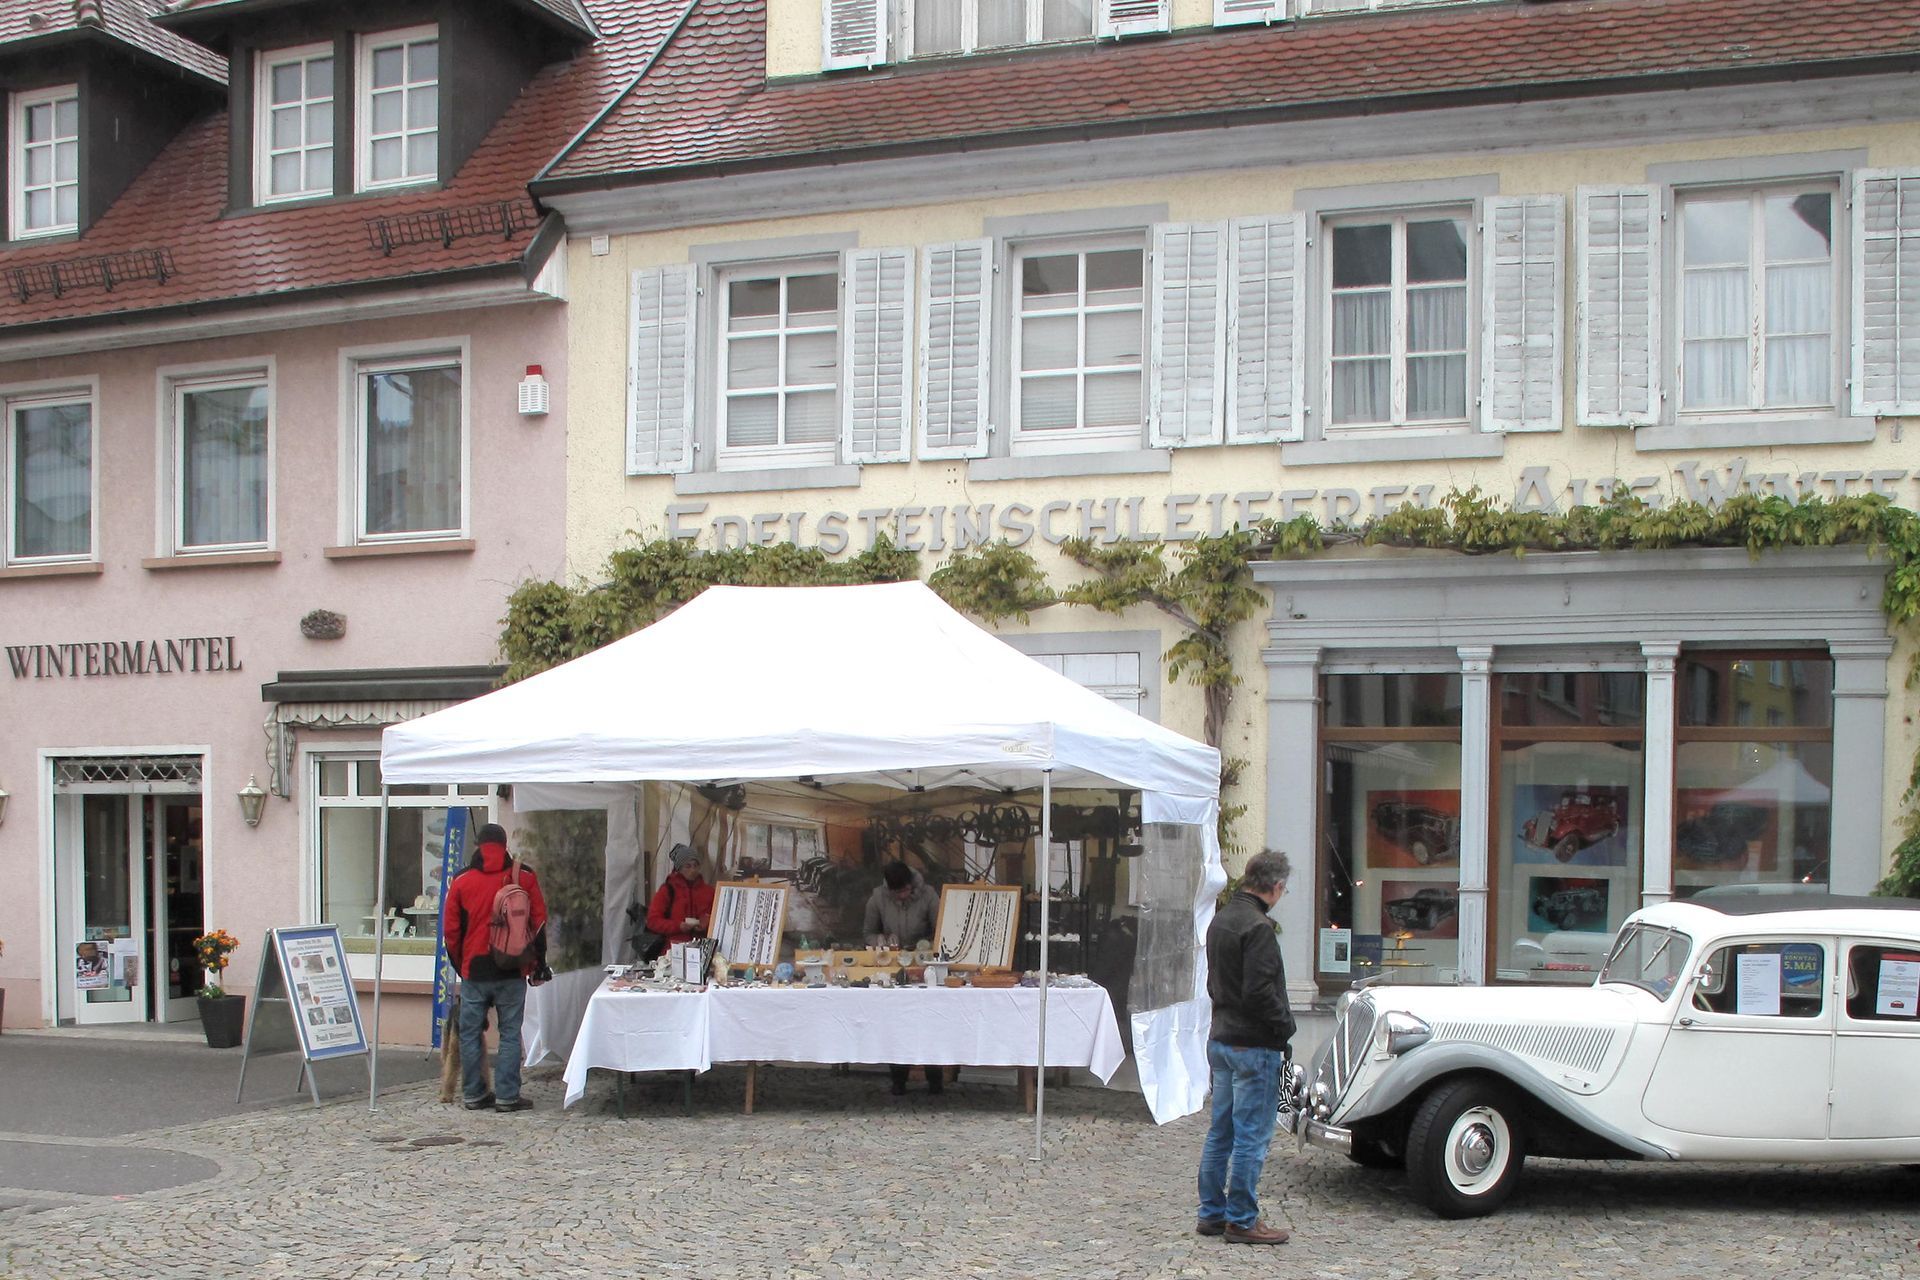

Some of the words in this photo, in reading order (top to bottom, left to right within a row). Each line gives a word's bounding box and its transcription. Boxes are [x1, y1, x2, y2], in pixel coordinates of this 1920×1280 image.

[5, 636, 243, 680] WINTERMANTEL
[1784, 961, 1793, 970] 5.
[1794, 961, 1817, 971] MAI
